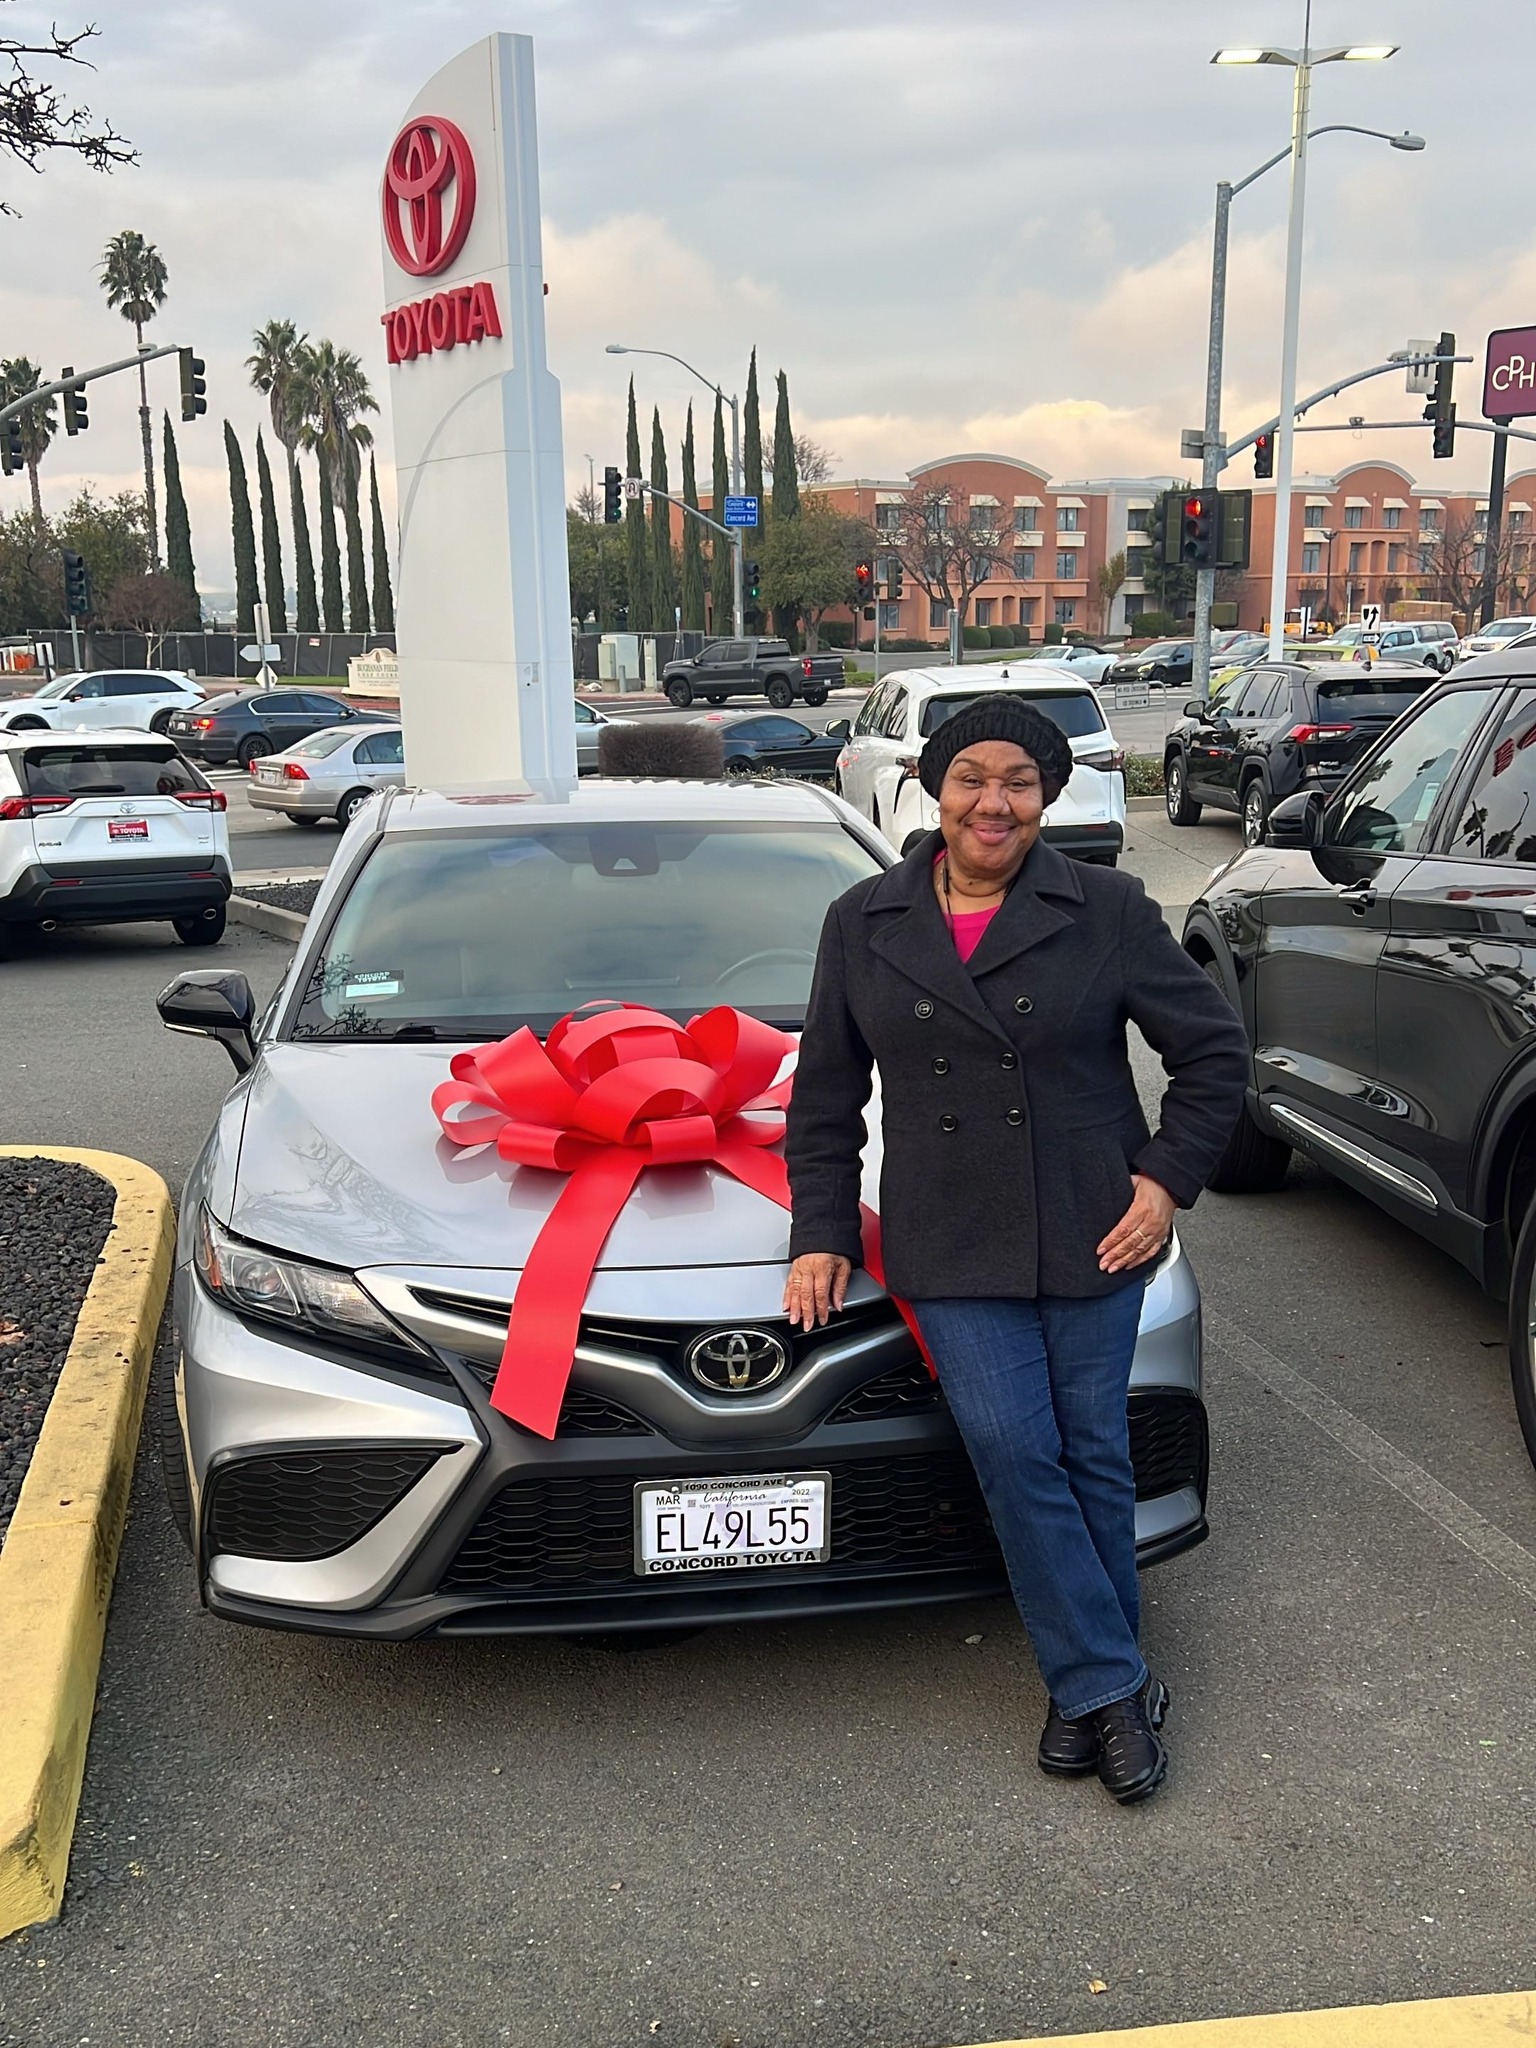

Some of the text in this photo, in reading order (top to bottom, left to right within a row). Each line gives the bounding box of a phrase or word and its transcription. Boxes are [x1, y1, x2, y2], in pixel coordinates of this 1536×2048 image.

[381, 282, 502, 365] TOYOTA
[726, 514, 756, 522] Concord Ave
[384, 664, 399, 672] FIELD
[354, 971, 390, 979] CONCORD
[710, 1480, 760, 1490] CONCORD
[763, 1479, 782, 1487] AVE
[792, 1488, 810, 1496] 2022
[656, 1494, 681, 1506] MAR
[704, 1490, 767, 1508] California
[656, 1506, 809, 1554] EL49L55
[649, 1550, 816, 1572] CONCORD TOYOTA
